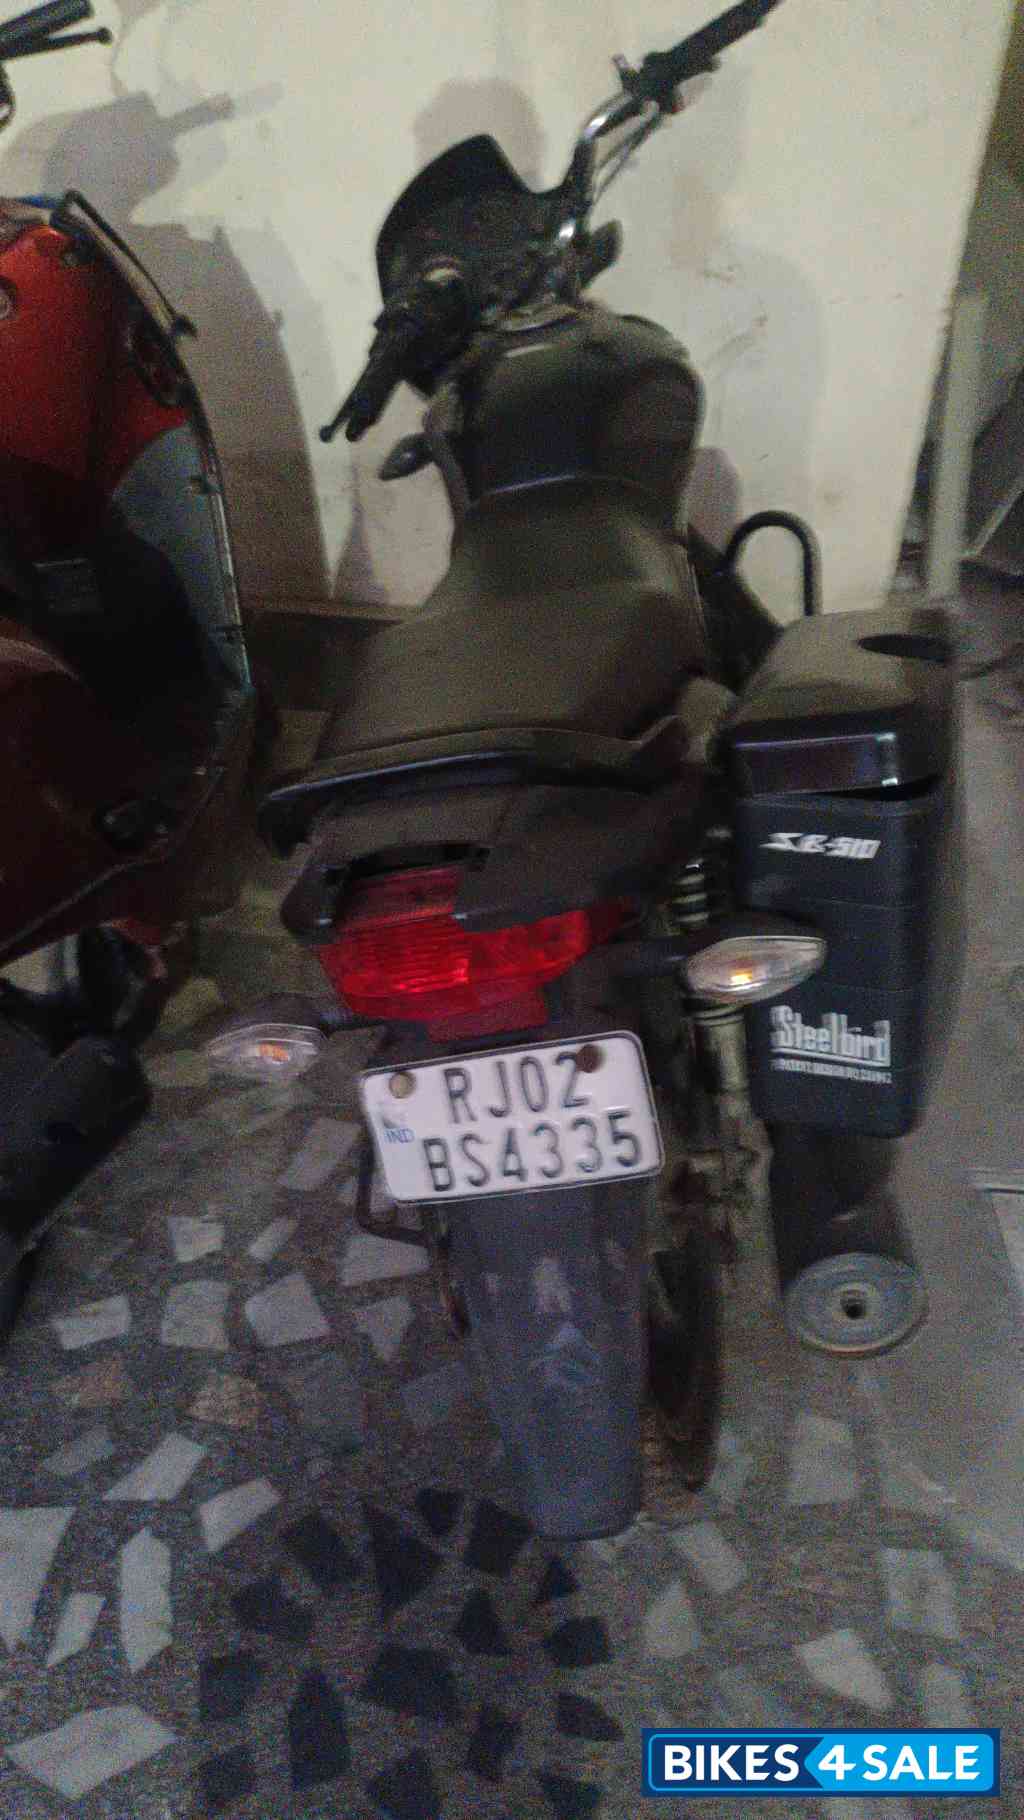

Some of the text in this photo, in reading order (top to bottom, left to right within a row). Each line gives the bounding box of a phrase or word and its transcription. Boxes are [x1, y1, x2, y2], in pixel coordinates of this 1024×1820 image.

[768, 1004, 892, 1064] Steelbird
[442, 1050, 593, 1124] RJ02
[383, 1127, 414, 1144] IND
[422, 1109, 643, 1192] BS4335
